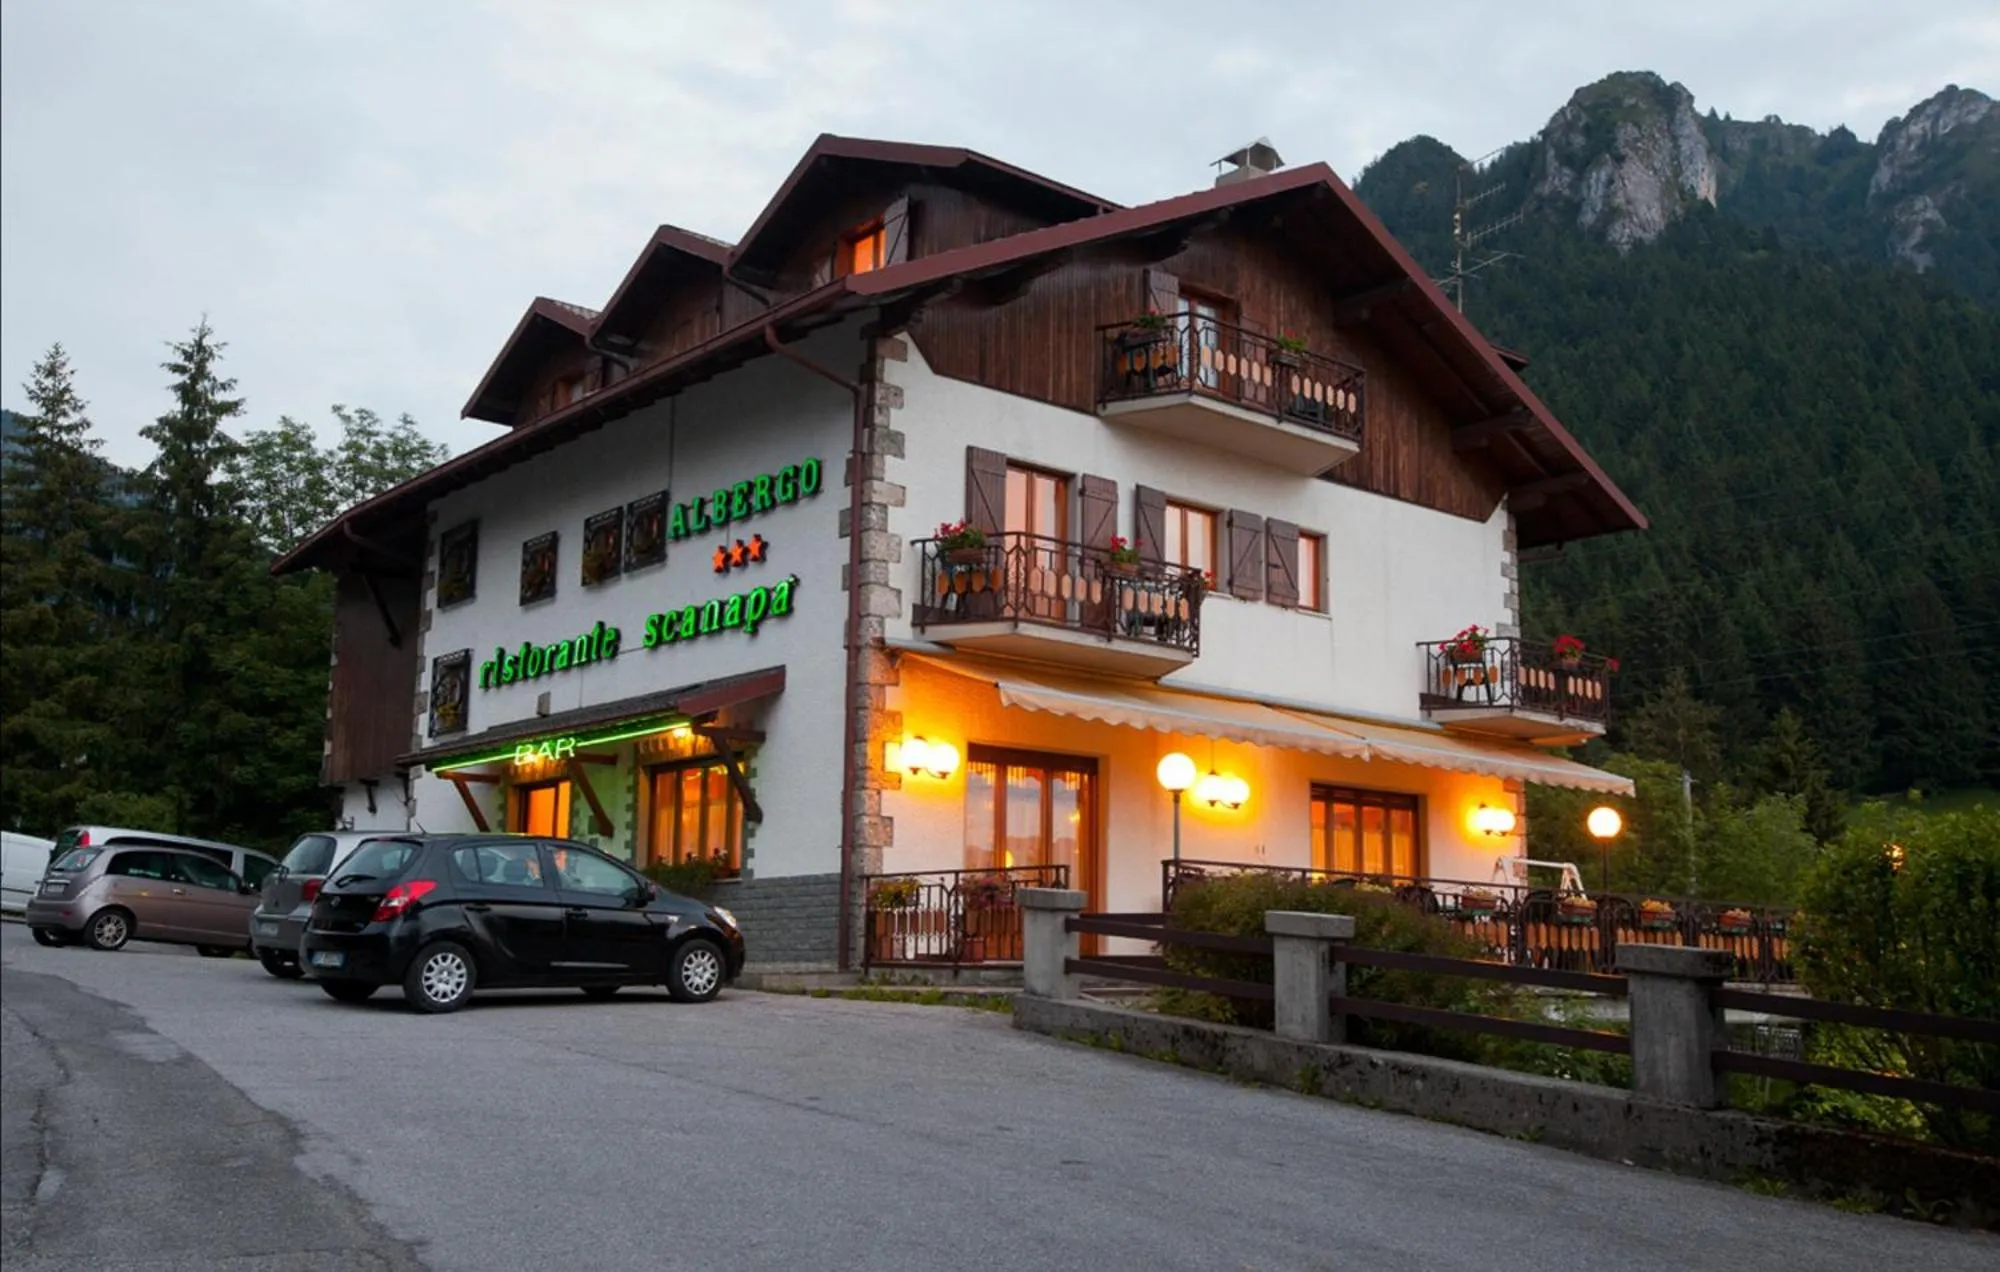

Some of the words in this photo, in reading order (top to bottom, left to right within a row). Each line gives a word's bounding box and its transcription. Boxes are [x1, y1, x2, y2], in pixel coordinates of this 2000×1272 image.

[667, 456, 822, 541] ALBERGO
[478, 620, 621, 691] ristorante
[514, 737, 576, 766] BAR
